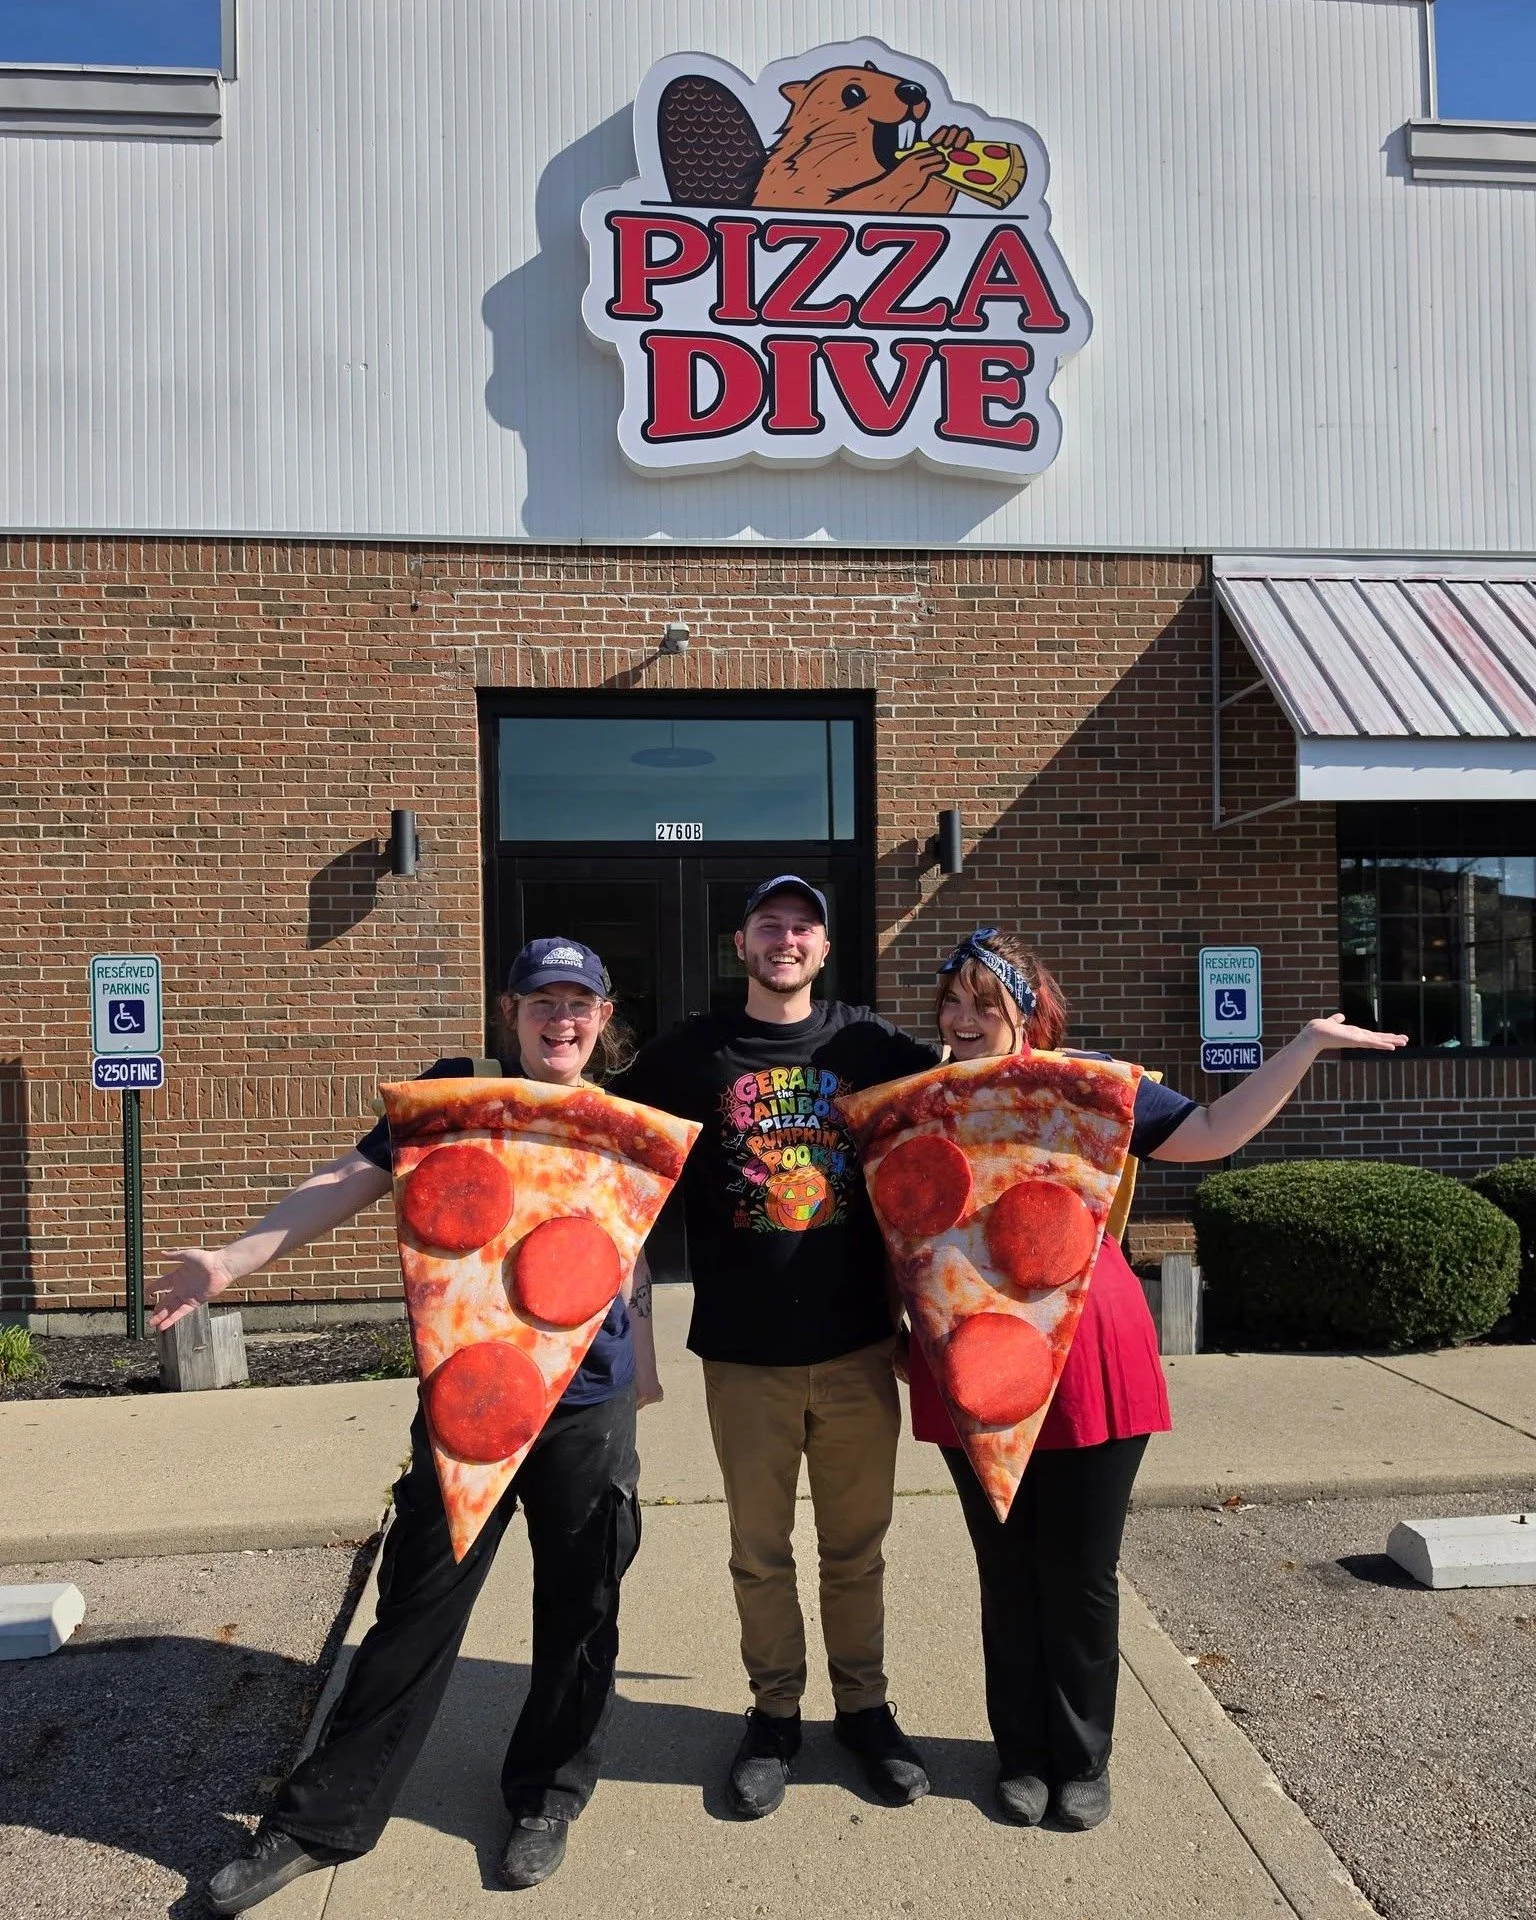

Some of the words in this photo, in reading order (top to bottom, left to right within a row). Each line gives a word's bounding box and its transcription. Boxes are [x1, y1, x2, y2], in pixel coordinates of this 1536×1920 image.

[605, 211, 1070, 333] PIZZA
[640, 330, 1039, 451] DIVE
[657, 824, 701, 840] 2760B
[1205, 957, 1255, 969] RESERVED
[97, 966, 154, 979] RESERVED
[1210, 973, 1251, 985] PARKING
[102, 983, 150, 995] PARKING
[1205, 1048, 1232, 1065] $250
[1233, 1048, 1257, 1064] FINE
[98, 1063, 128, 1082] $250
[130, 1063, 157, 1081] FINE
[733, 1066, 839, 1102] GERALD
[776, 1089, 794, 1099] the
[759, 1115, 821, 1133] PIZZA
[746, 1130, 840, 1155] PUMPKIN
[742, 1145, 847, 1186] SPOOKY
